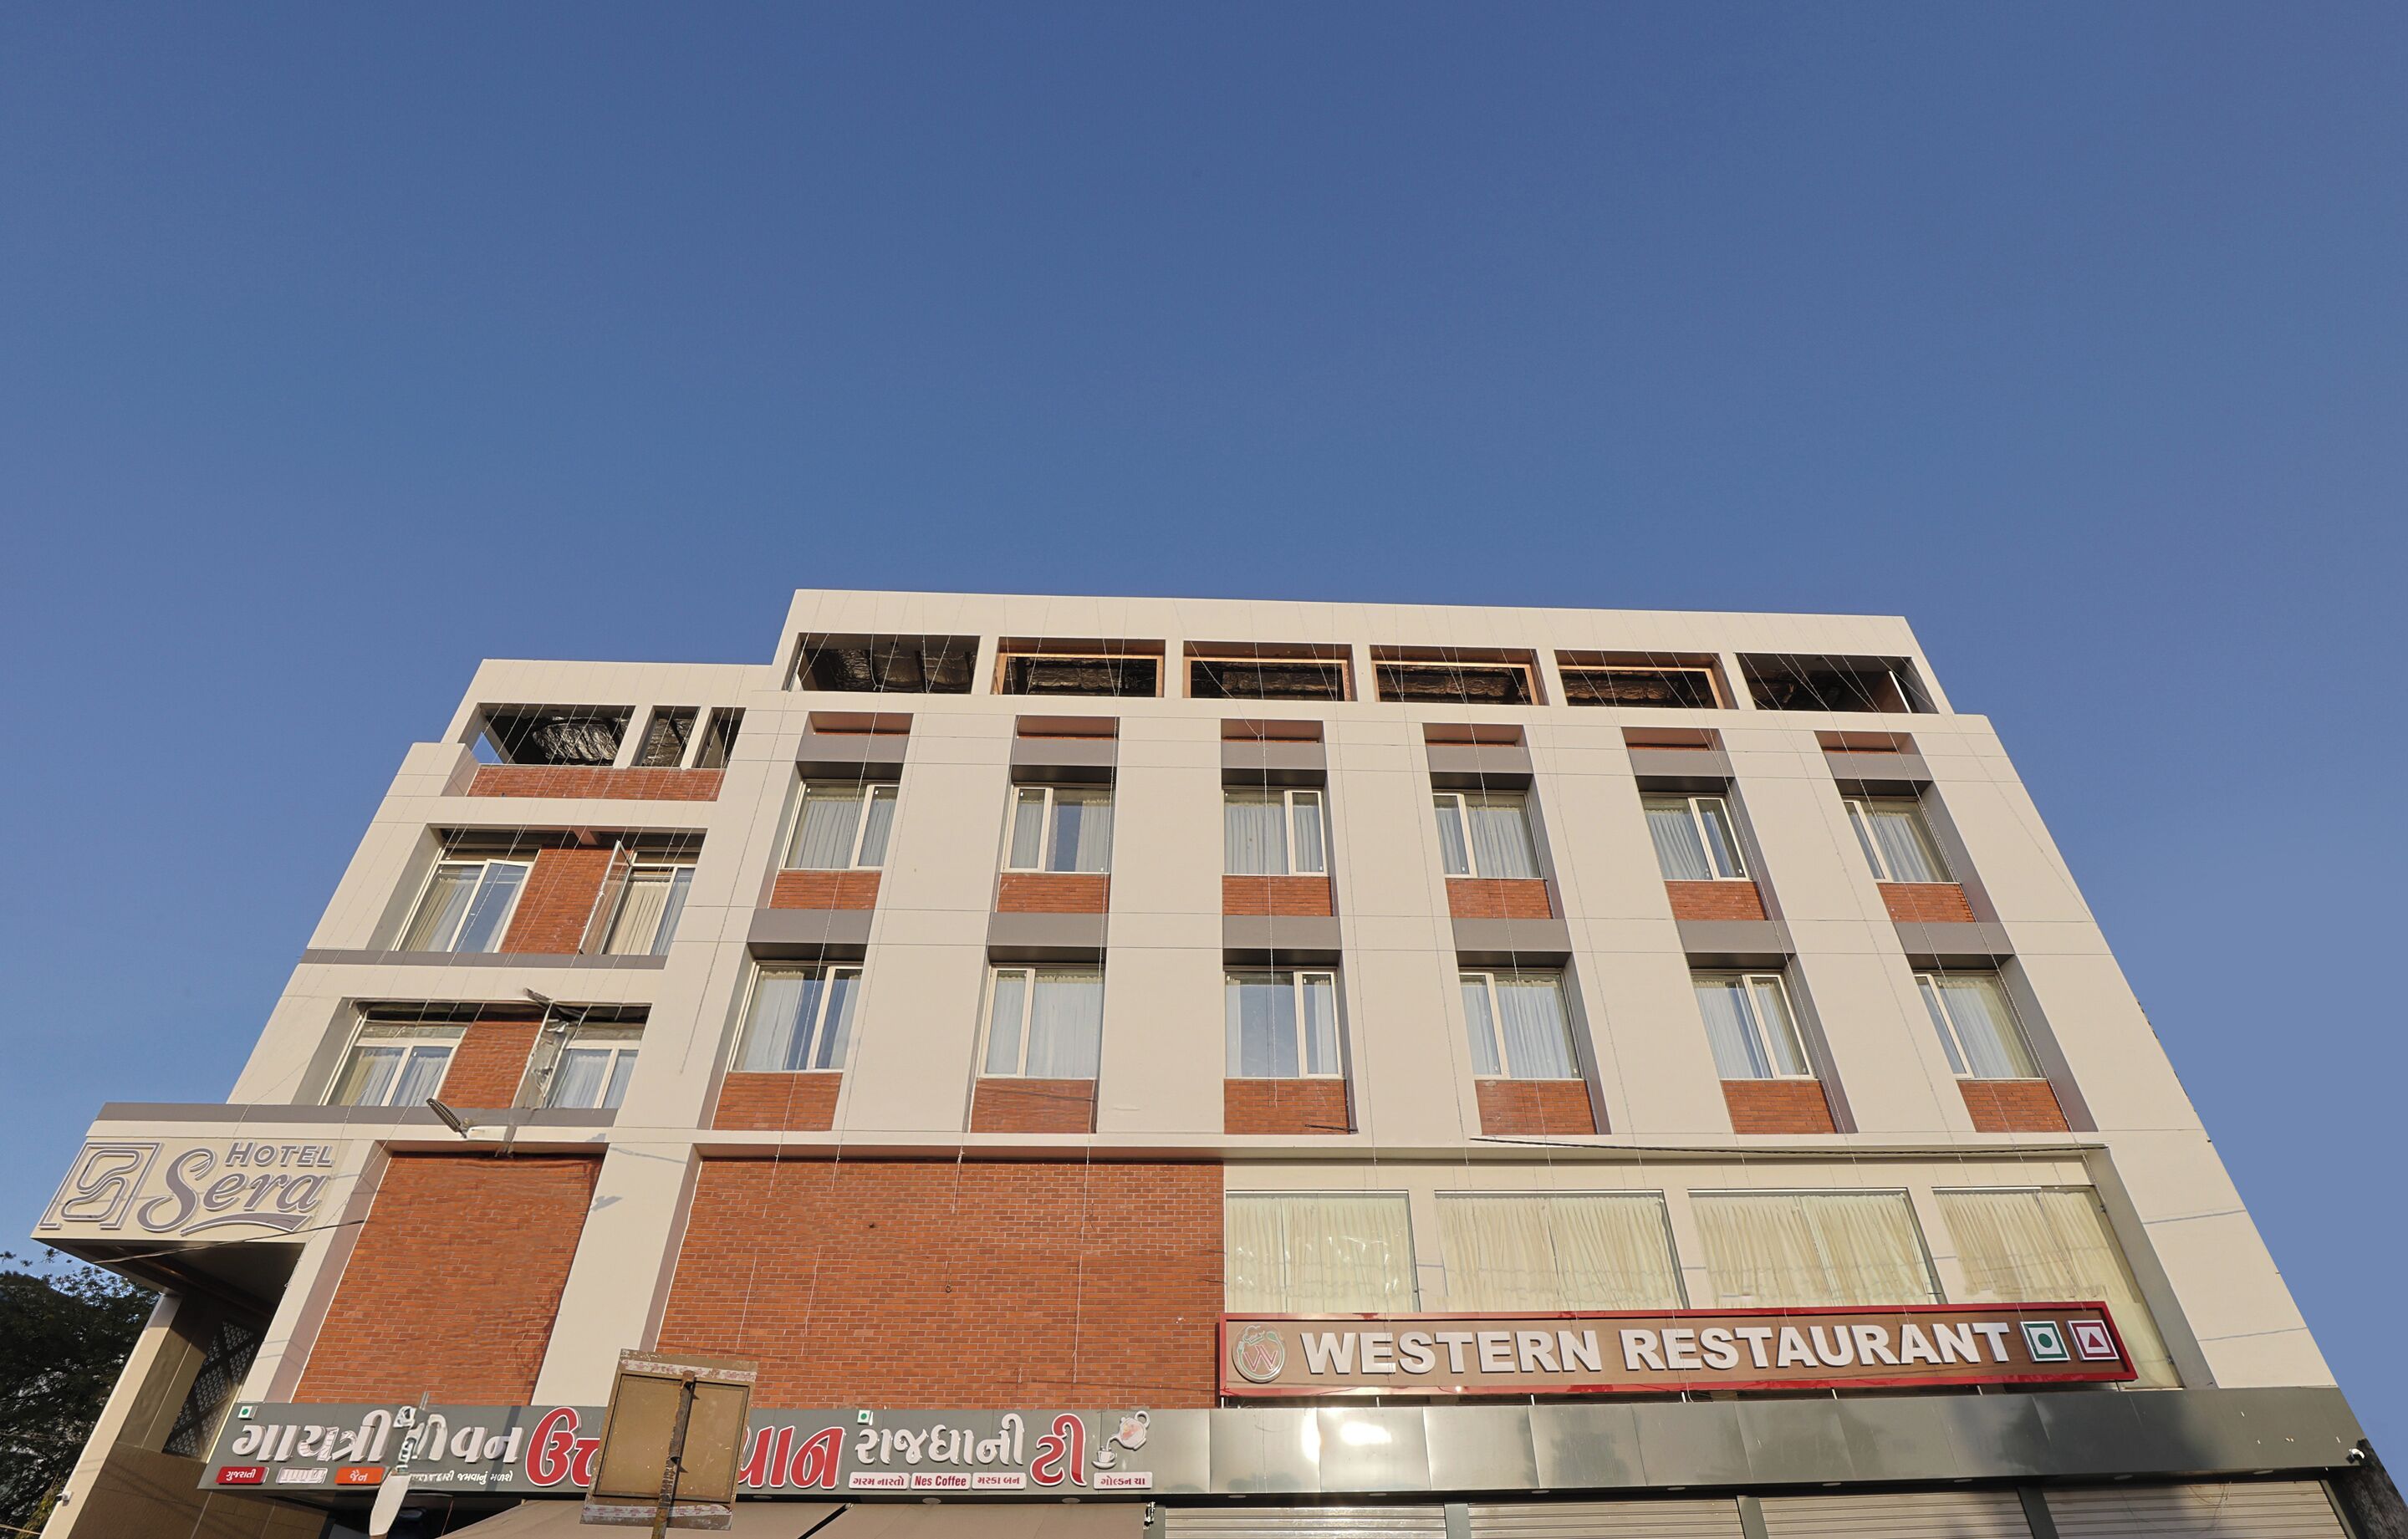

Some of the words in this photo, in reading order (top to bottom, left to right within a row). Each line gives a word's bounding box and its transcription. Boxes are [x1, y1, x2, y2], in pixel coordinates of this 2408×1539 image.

[224, 1142, 333, 1167] HOTEL
[137, 1148, 329, 1233] Sera
[1300, 1331, 1602, 1374] WESTERN
[1619, 1322, 2010, 1371] RESTAURANT
[232, 1409, 392, 1462] ગાયત્રી
[855, 1413, 1025, 1465] રાજધાની
[1029, 1413, 1088, 1486] ટી
[226, 1469, 256, 1480] ગુજરાતી
[915, 1475, 932, 1486] Nes
[935, 1475, 967, 1486] Coffee
